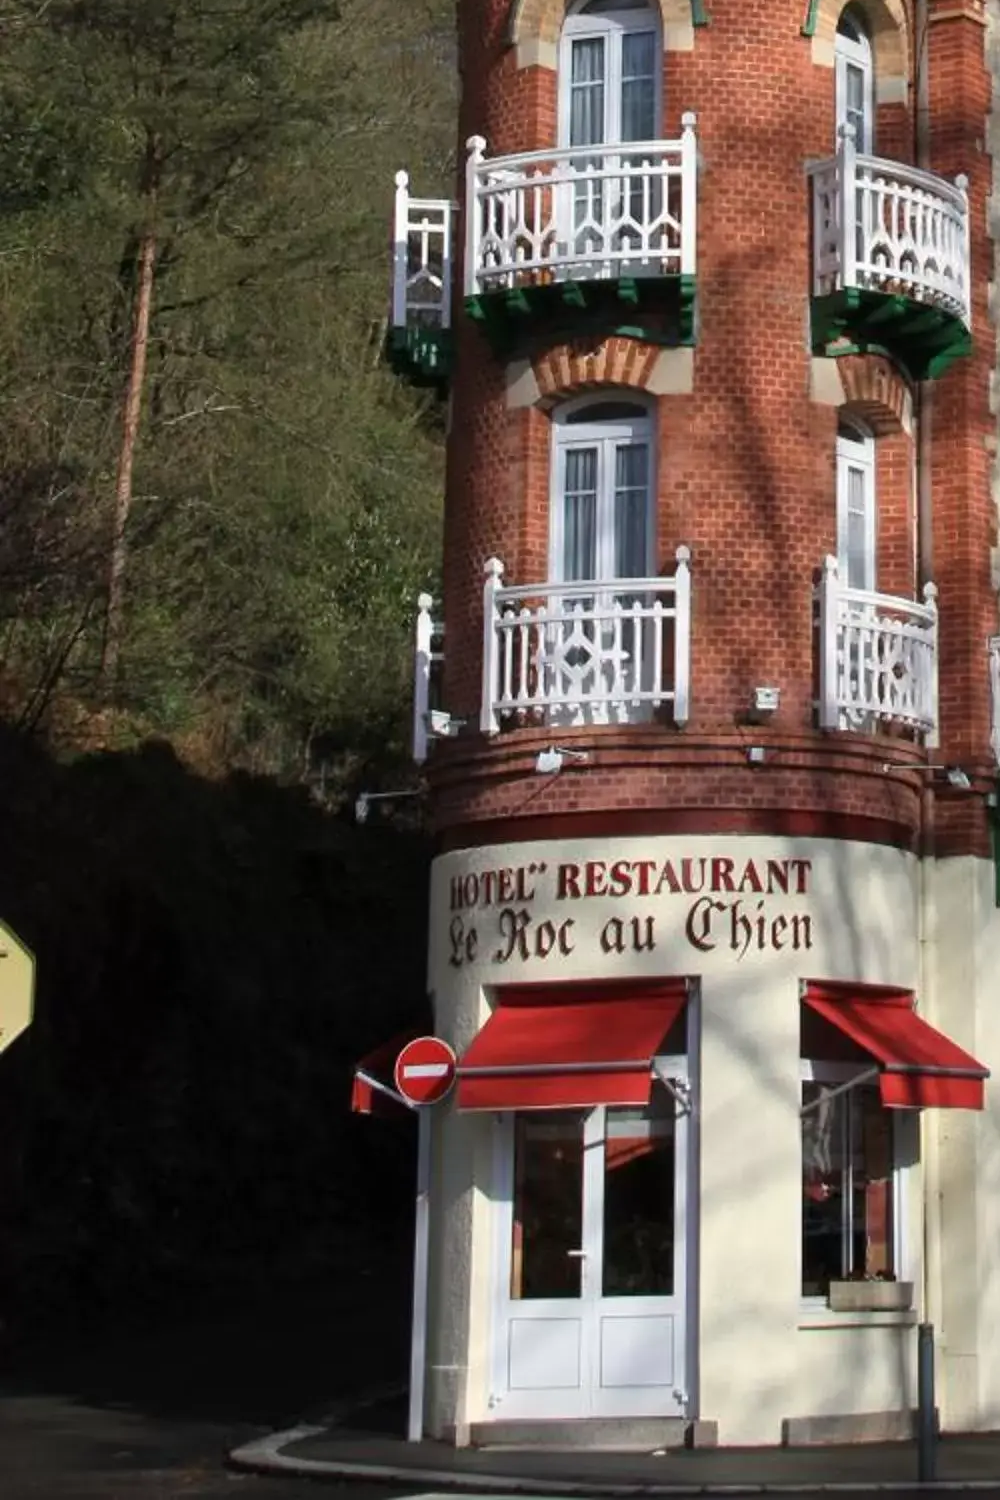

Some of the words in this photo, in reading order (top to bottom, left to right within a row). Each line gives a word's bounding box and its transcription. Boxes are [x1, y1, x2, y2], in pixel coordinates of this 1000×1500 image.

[557, 857, 812, 900] RESTAURANT
[449, 915, 479, 967] Le
[496, 907, 576, 964] Roc
[600, 915, 656, 954] au
[685, 896, 813, 961] Chien
